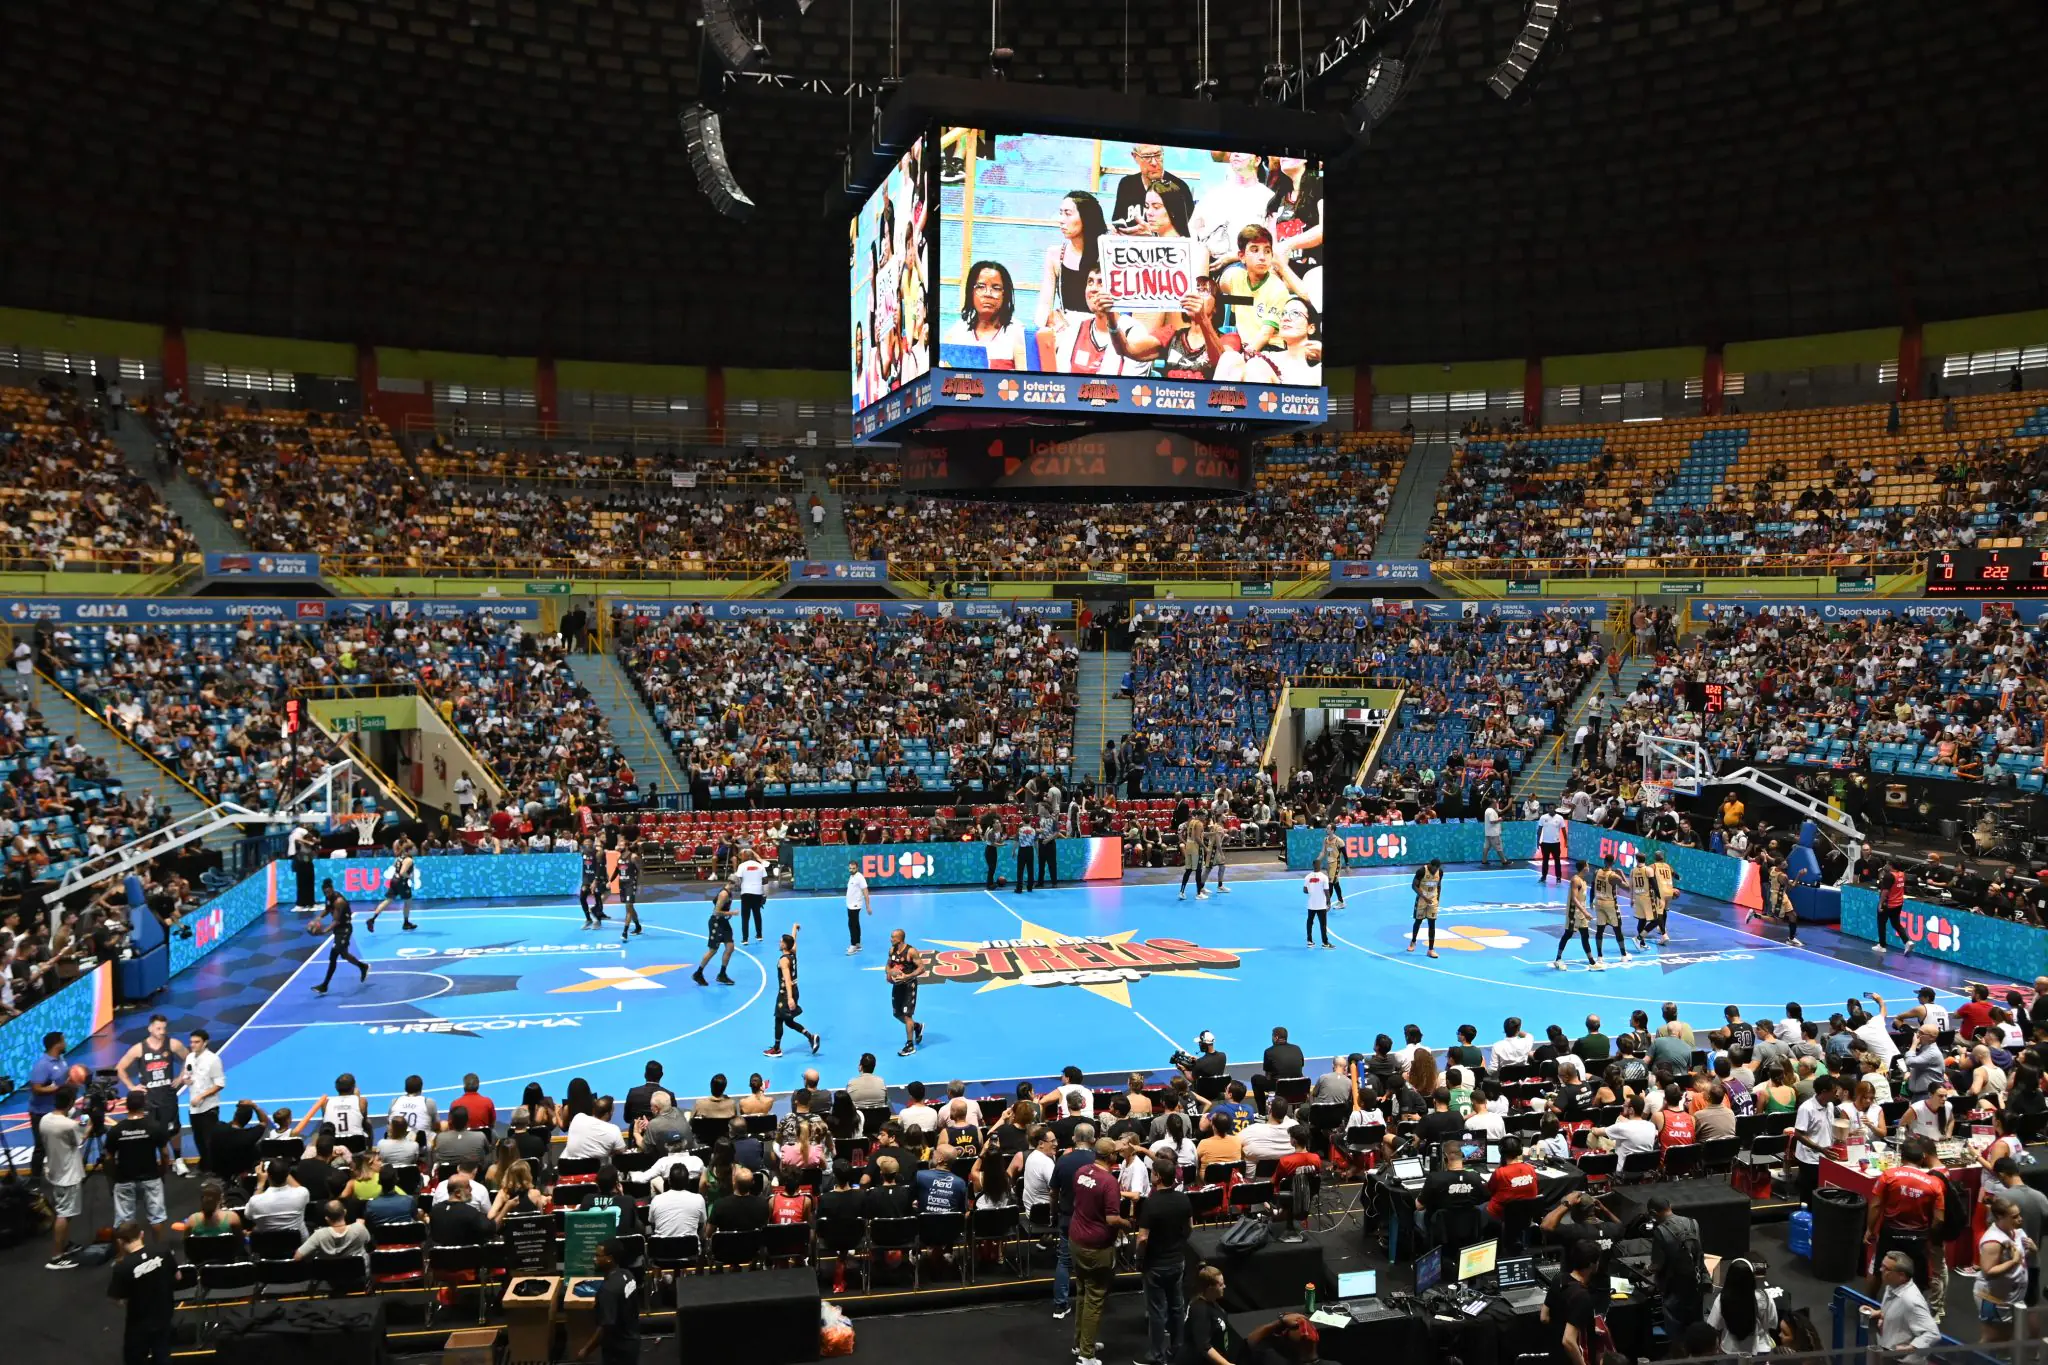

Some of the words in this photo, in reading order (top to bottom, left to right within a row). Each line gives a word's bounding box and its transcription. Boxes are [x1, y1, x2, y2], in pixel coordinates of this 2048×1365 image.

[1114, 246, 1178, 266] EQUIPE
[1109, 268, 1189, 298] ELINHO
[1023, 381, 1066, 392] loterias
[1155, 386, 1196, 398] loterias
[1023, 392, 1066, 404] CAIXA
[1155, 398, 1196, 410] CAIXA
[1281, 392, 1320, 404] loterias
[1281, 402, 1320, 416] CAIXA
[1029, 438, 1105, 456] loterias
[1029, 457, 1106, 476] CAIXA
[1944, 567, 1953, 579] 0
[1983, 566, 2009, 578] 2:22
[76, 604, 128, 618] CAIXA
[1708, 696, 1722, 712] 24
[1346, 836, 1374, 858] EU
[862, 854, 895, 878] EU
[346, 868, 380, 892] EU
[1634, 876, 1644, 888] 10
[982, 938, 1046, 949] JOGO
[1056, 936, 1106, 946] DAS
[444, 942, 622, 959] Sportsbet.io
[402, 1017, 582, 1035] RECOMA
[1734, 1031, 1752, 1046] 30
[337, 1112, 349, 1132] 3
